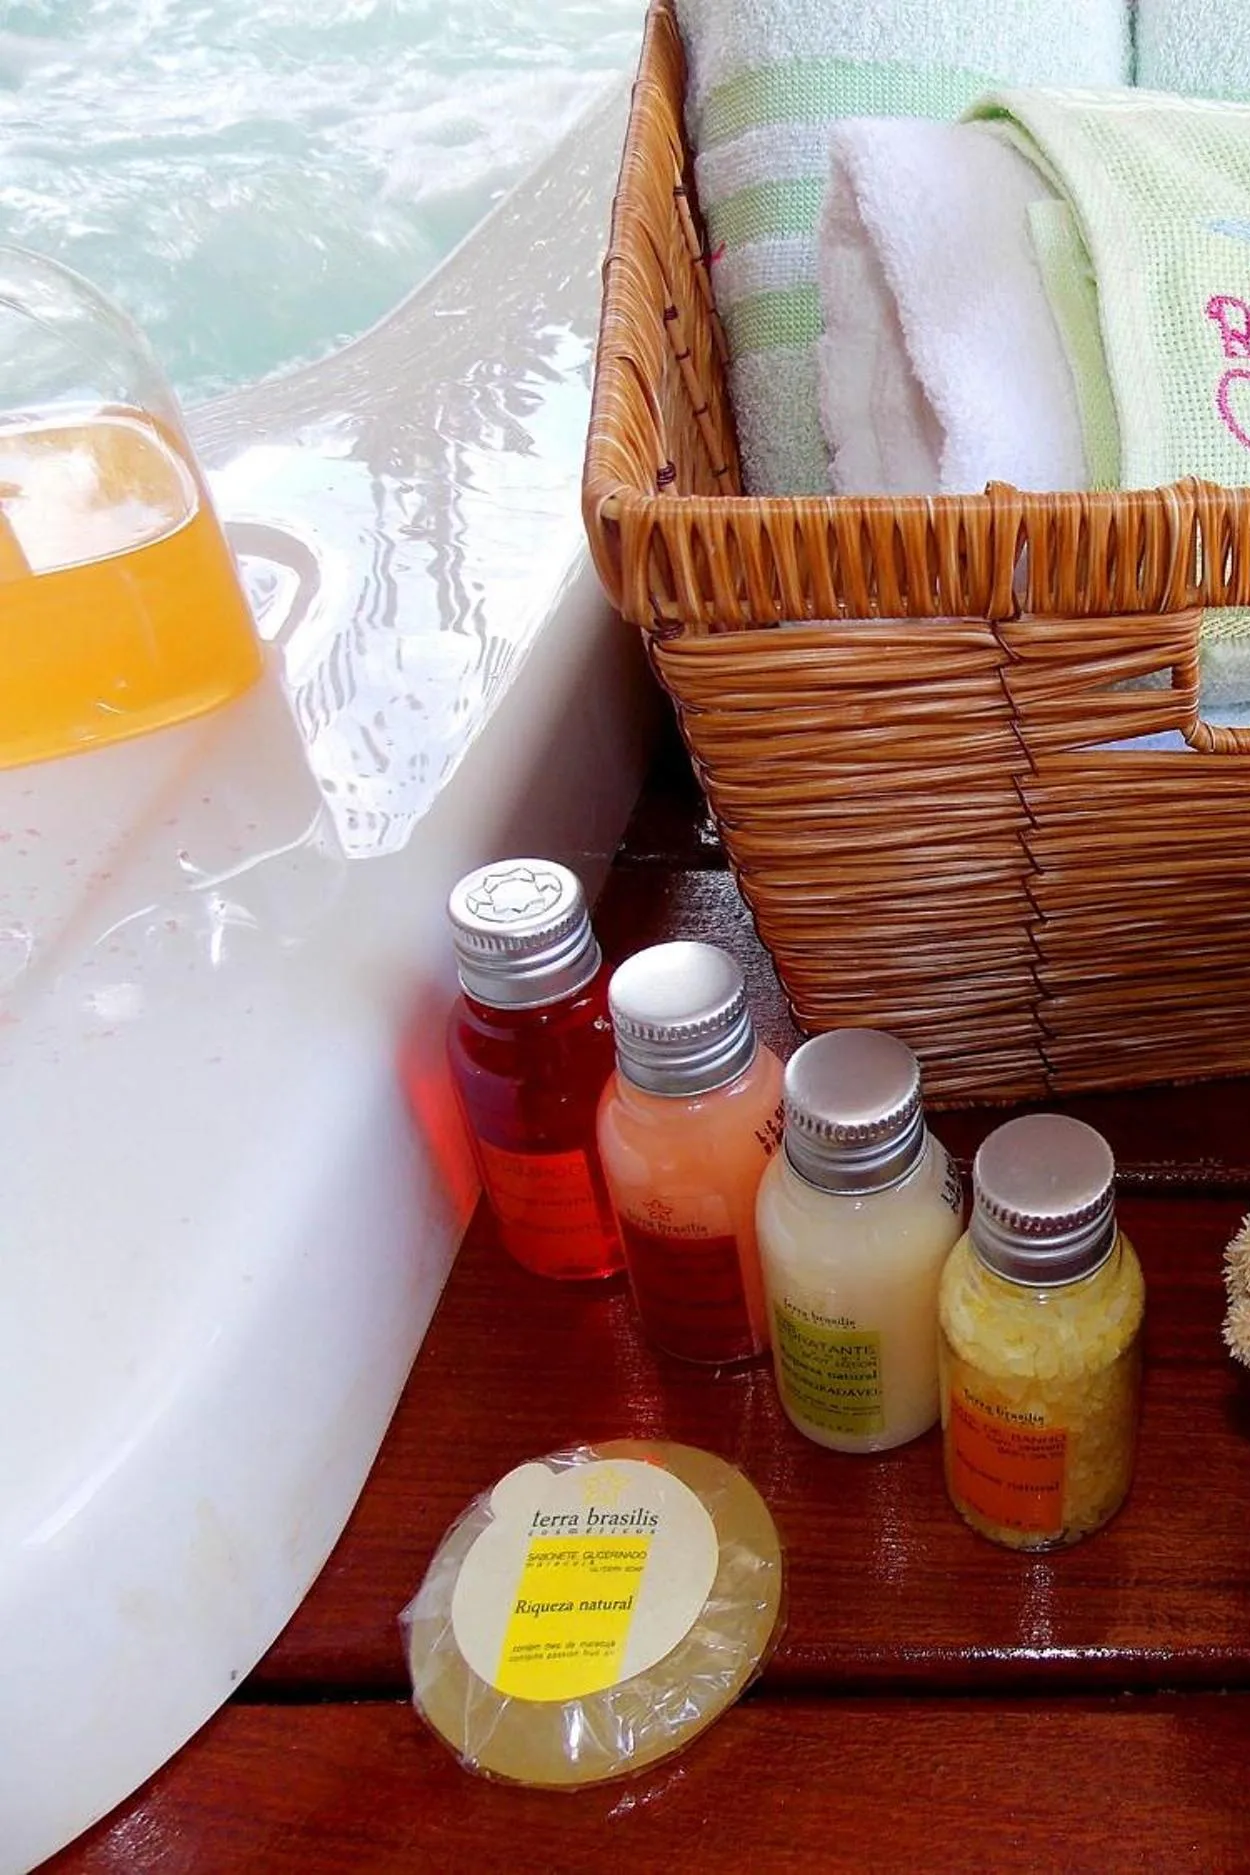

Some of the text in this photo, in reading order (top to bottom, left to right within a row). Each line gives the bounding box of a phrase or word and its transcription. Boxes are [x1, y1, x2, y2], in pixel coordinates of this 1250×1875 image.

[532, 1507, 659, 1527] terra brasilis
[515, 1595, 633, 1618] Riqueza natural
